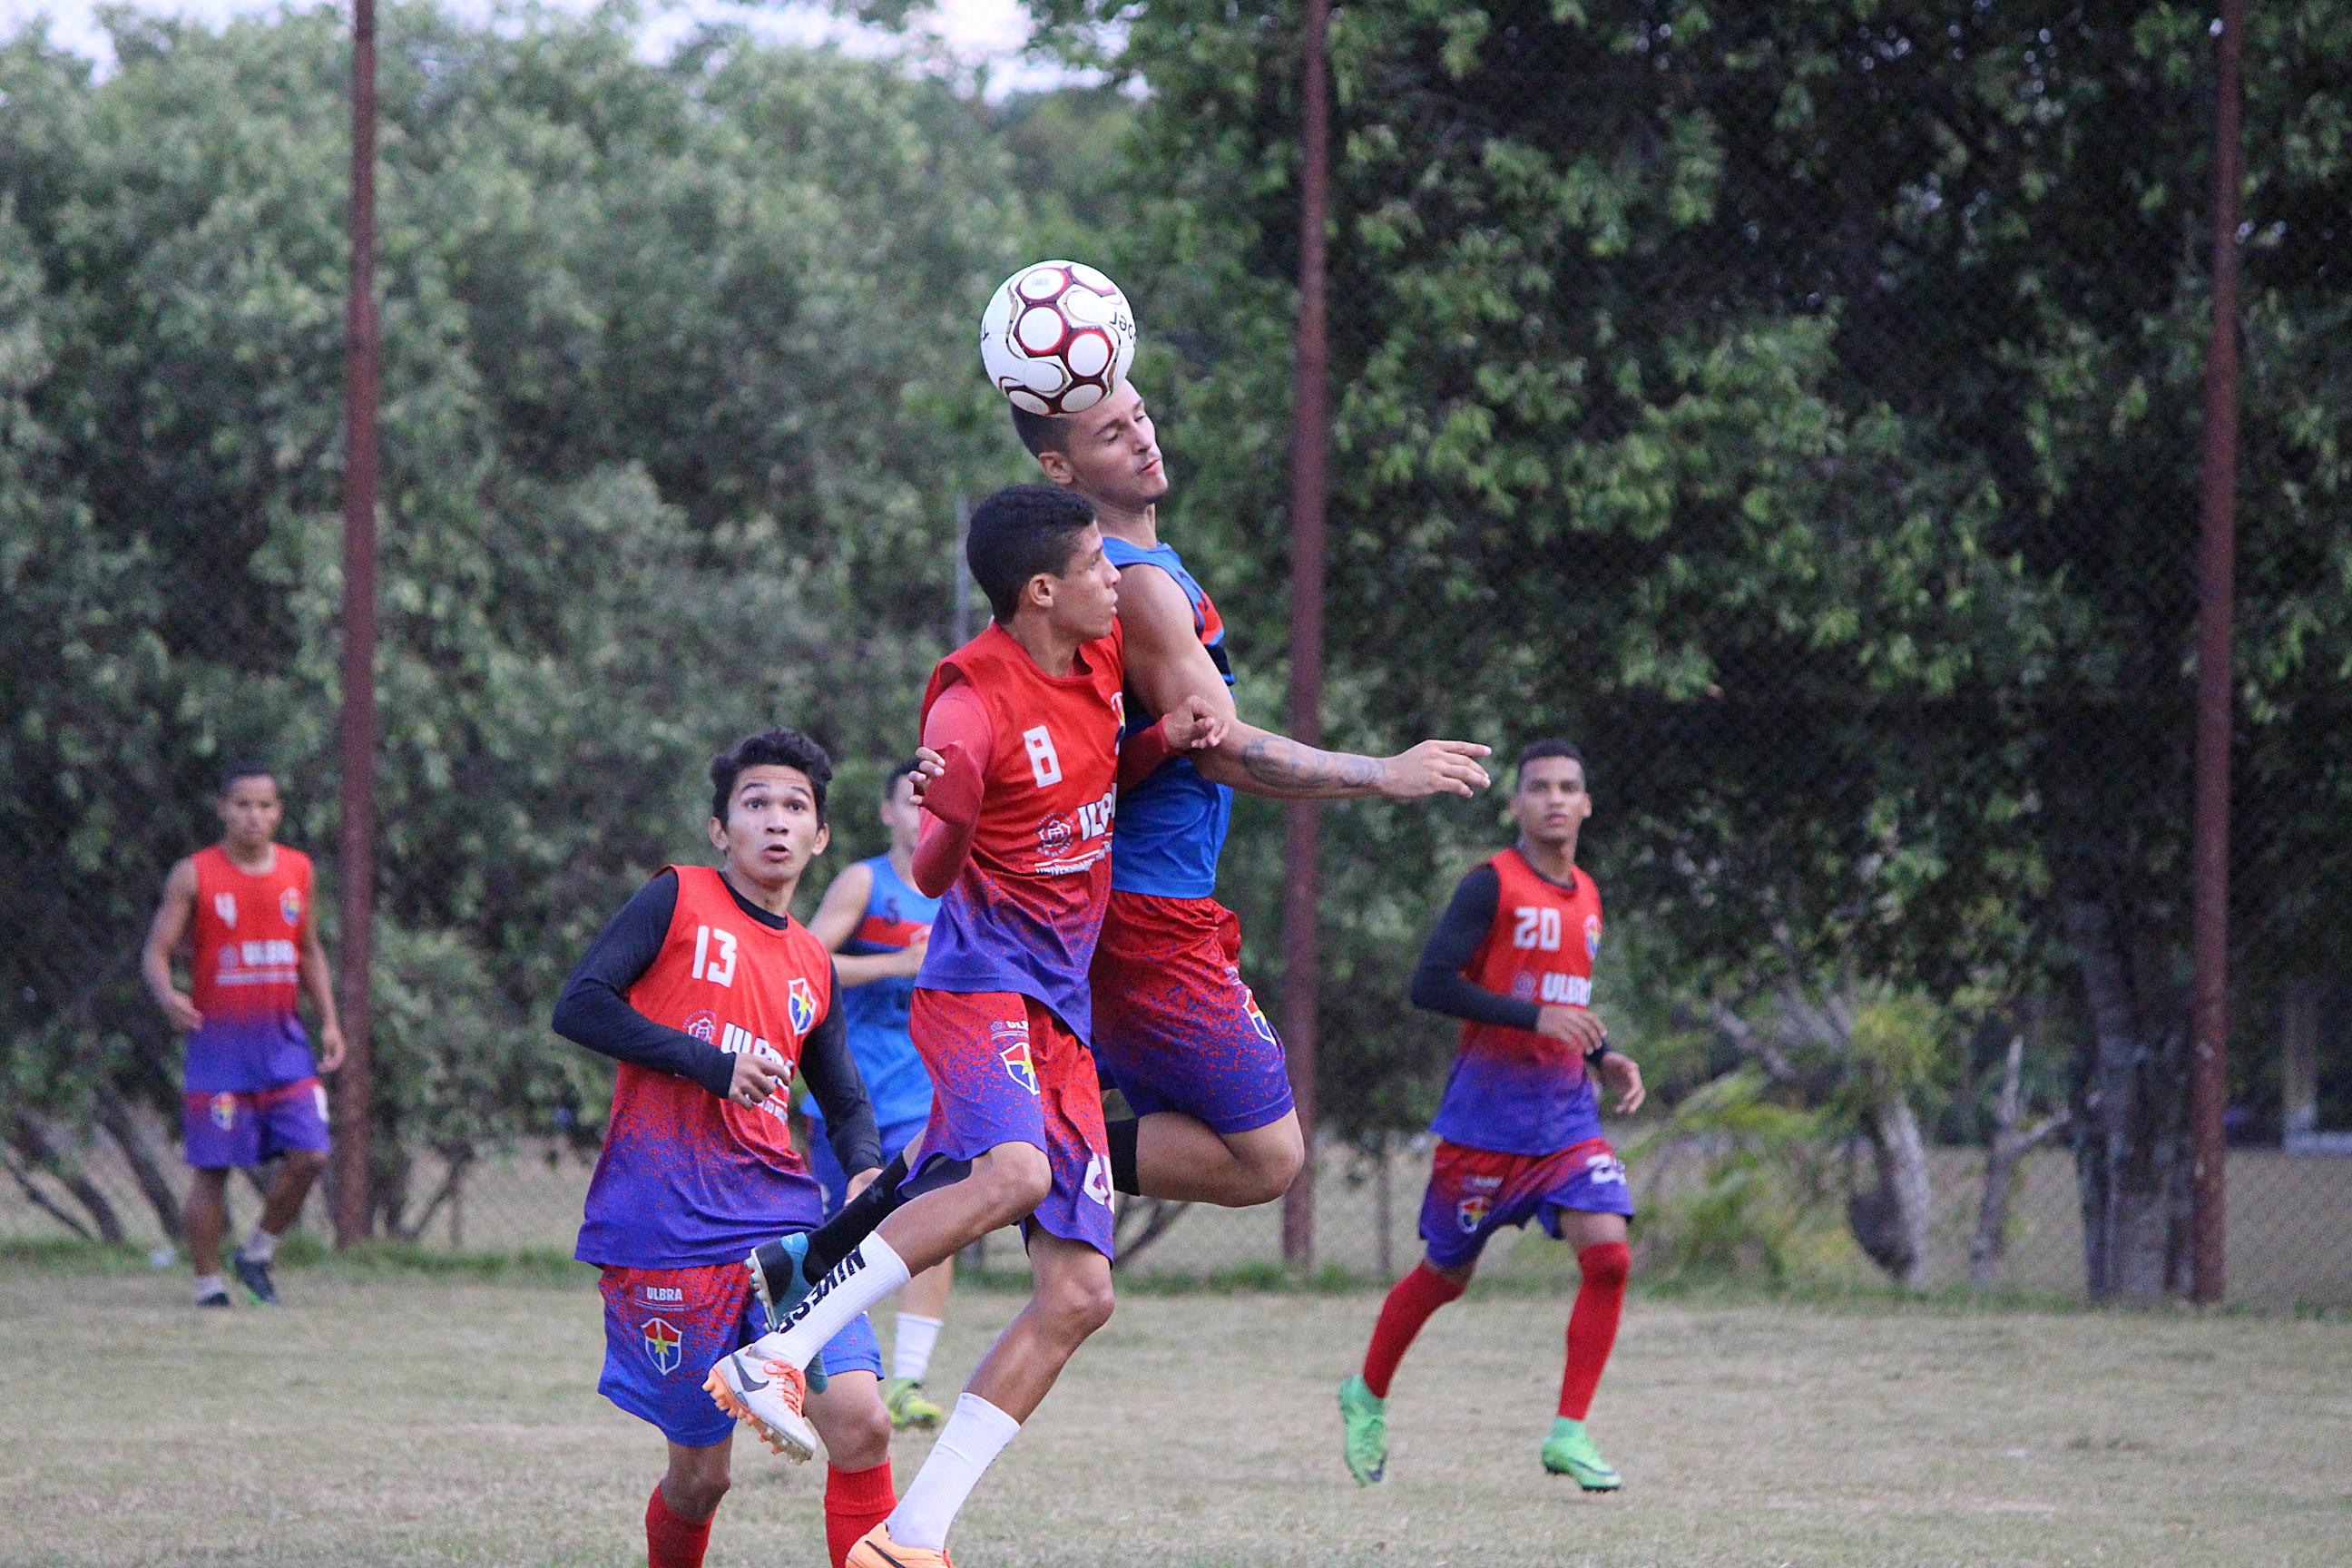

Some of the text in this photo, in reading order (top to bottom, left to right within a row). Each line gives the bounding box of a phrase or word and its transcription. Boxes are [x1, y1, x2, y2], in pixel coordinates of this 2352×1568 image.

[1023, 725, 1063, 789] 8
[1514, 906, 1562, 951] 20
[691, 925, 738, 988] 13
[646, 1286, 683, 1302] ULBRA
